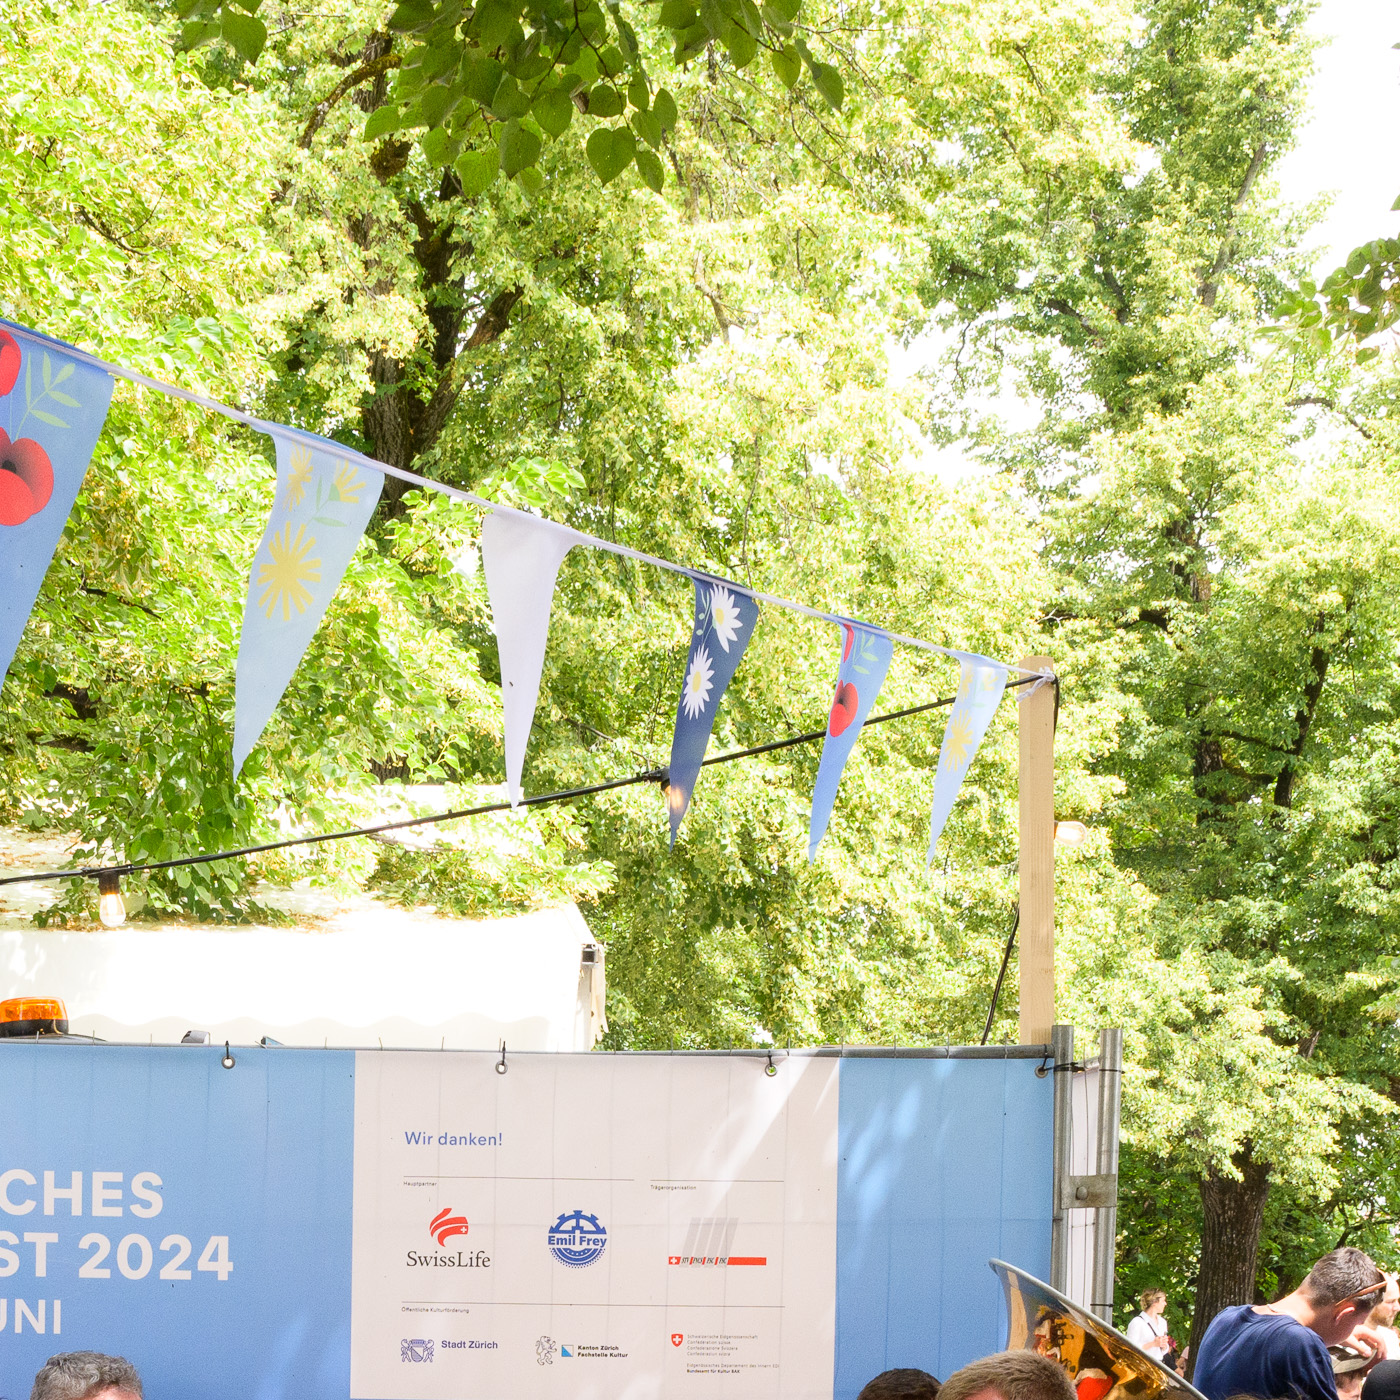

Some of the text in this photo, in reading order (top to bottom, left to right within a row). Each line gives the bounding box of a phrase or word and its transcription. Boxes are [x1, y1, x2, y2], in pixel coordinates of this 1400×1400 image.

[404, 1131, 503, 1146] Wir danken!
[403, 1180, 438, 1188] Hauptpartner
[547, 1234, 608, 1249] Emil Frey
[78, 1233, 234, 1281] 2024
[406, 1250, 491, 1268] SwissLife
[440, 1340, 499, 1350] Stadt Zürich
